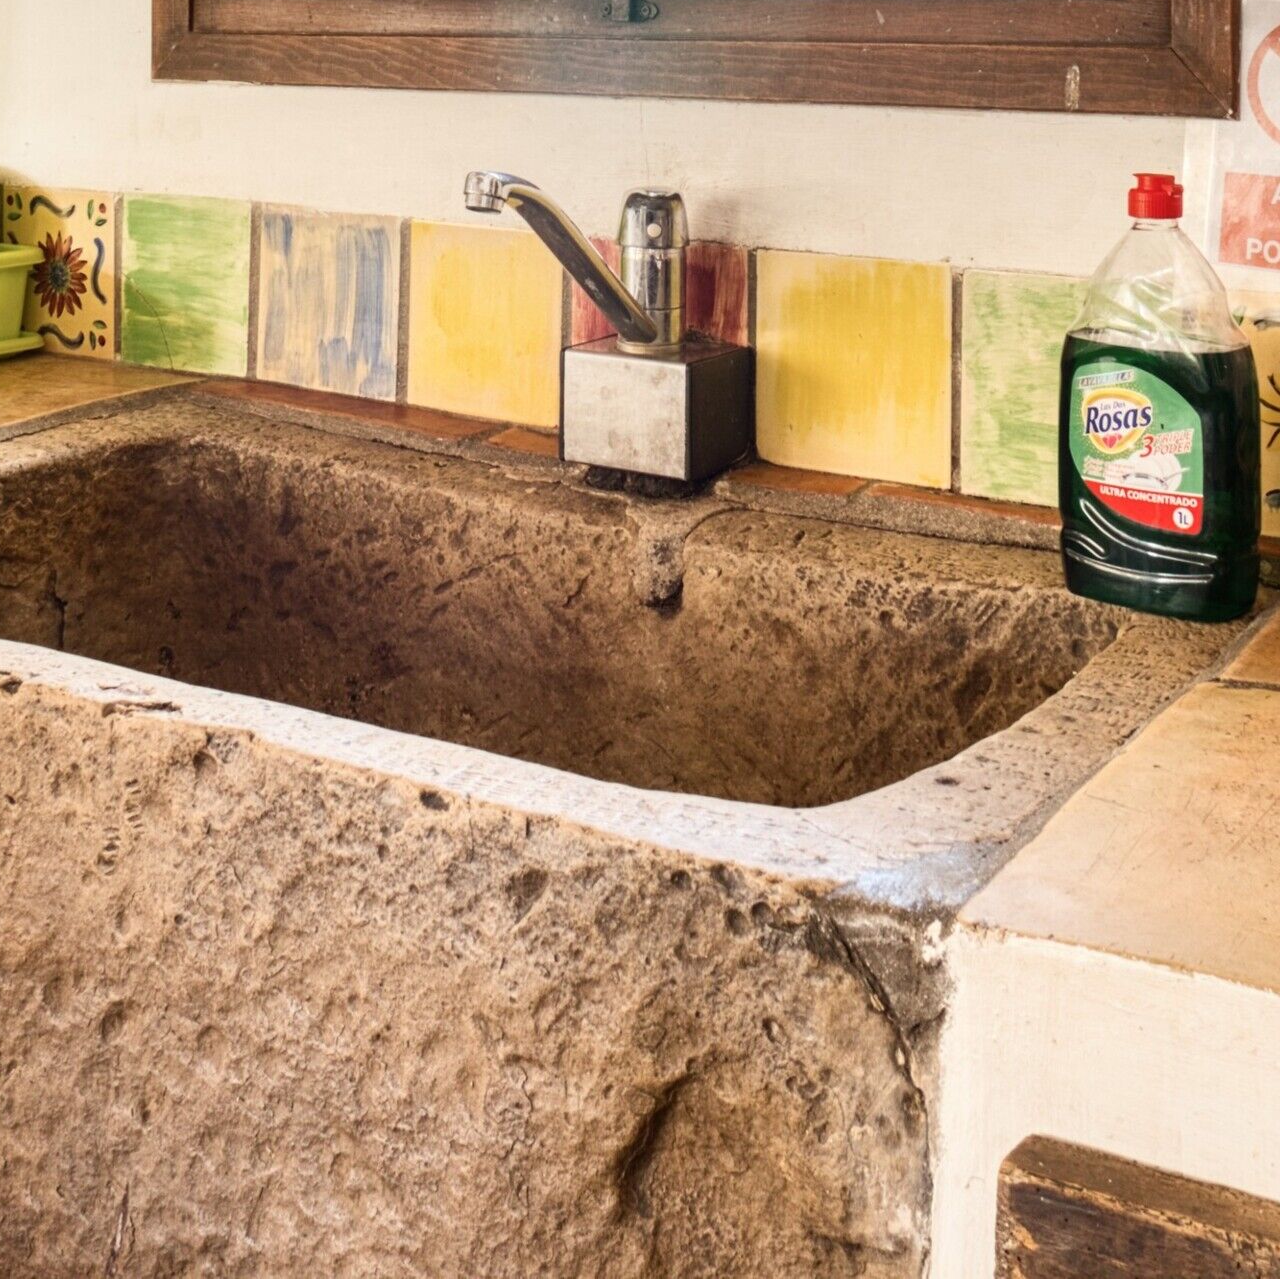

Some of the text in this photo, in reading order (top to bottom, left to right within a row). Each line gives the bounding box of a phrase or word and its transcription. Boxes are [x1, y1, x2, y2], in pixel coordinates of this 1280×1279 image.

[1086, 406, 1152, 434] Rosas
[1139, 435, 1154, 458] 3
[1153, 442, 1191, 456] PODER
[1100, 485, 1198, 508] ULTRA CONCENTRADO
[1178, 511, 1189, 526] 1L
